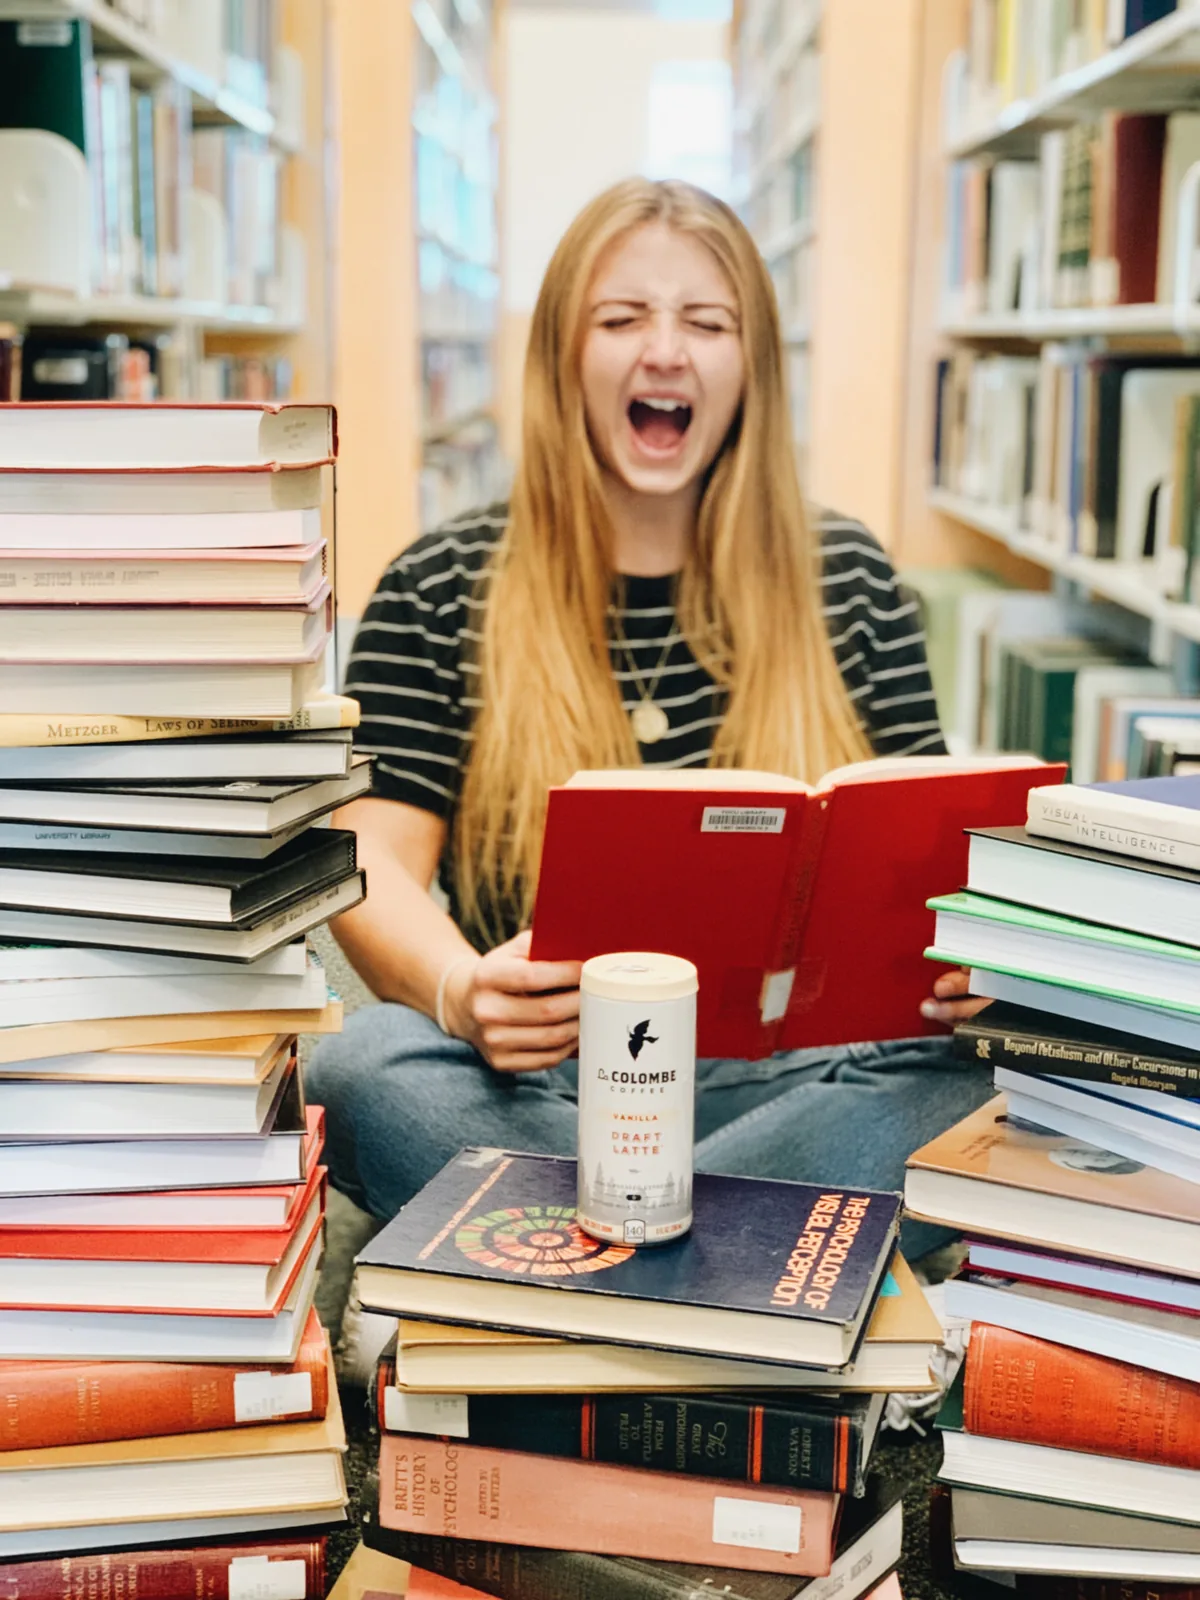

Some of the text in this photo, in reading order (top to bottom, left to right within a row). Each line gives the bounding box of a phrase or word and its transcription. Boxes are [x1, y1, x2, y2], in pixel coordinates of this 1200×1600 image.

[47, 718, 259, 738] METZGER LAWS OF SEEING
[1041, 806, 1088, 824] VISUAL
[34, 832, 112, 840] UNIVERSITY LIBRARY
[1076, 826, 1176, 856] INTELLIGENCE
[1003, 1038, 1038, 1056] Beyond
[1084, 1051, 1102, 1065] and
[1102, 1052, 1132, 1069] Other
[1131, 1057, 1187, 1079] Excursions
[611, 1070, 677, 1084] COLOMBE
[610, 1086, 665, 1094] COFFEE
[612, 1113, 659, 1121] VANILLA
[611, 1131, 662, 1143] DRAFT
[612, 1145, 661, 1155] LATTE
[625, 1226, 644, 1237] 140
[810, 1217, 862, 1293] PSYCHOLOGY
[803, 1290, 830, 1311] OF
[631, 1424, 641, 1441] TO
[654, 1419, 665, 1451] FROM
[691, 1423, 702, 1456] GREAT
[704, 1421, 728, 1459] The
[788, 1427, 800, 1477] WATSON
[801, 1426, 812, 1468] ROBERT
[395, 1454, 409, 1511] BRETT'S
[412, 1453, 426, 1518] HISTORY
[429, 1478, 441, 1495] OF
[101, 1556, 111, 1600] OUSAND
